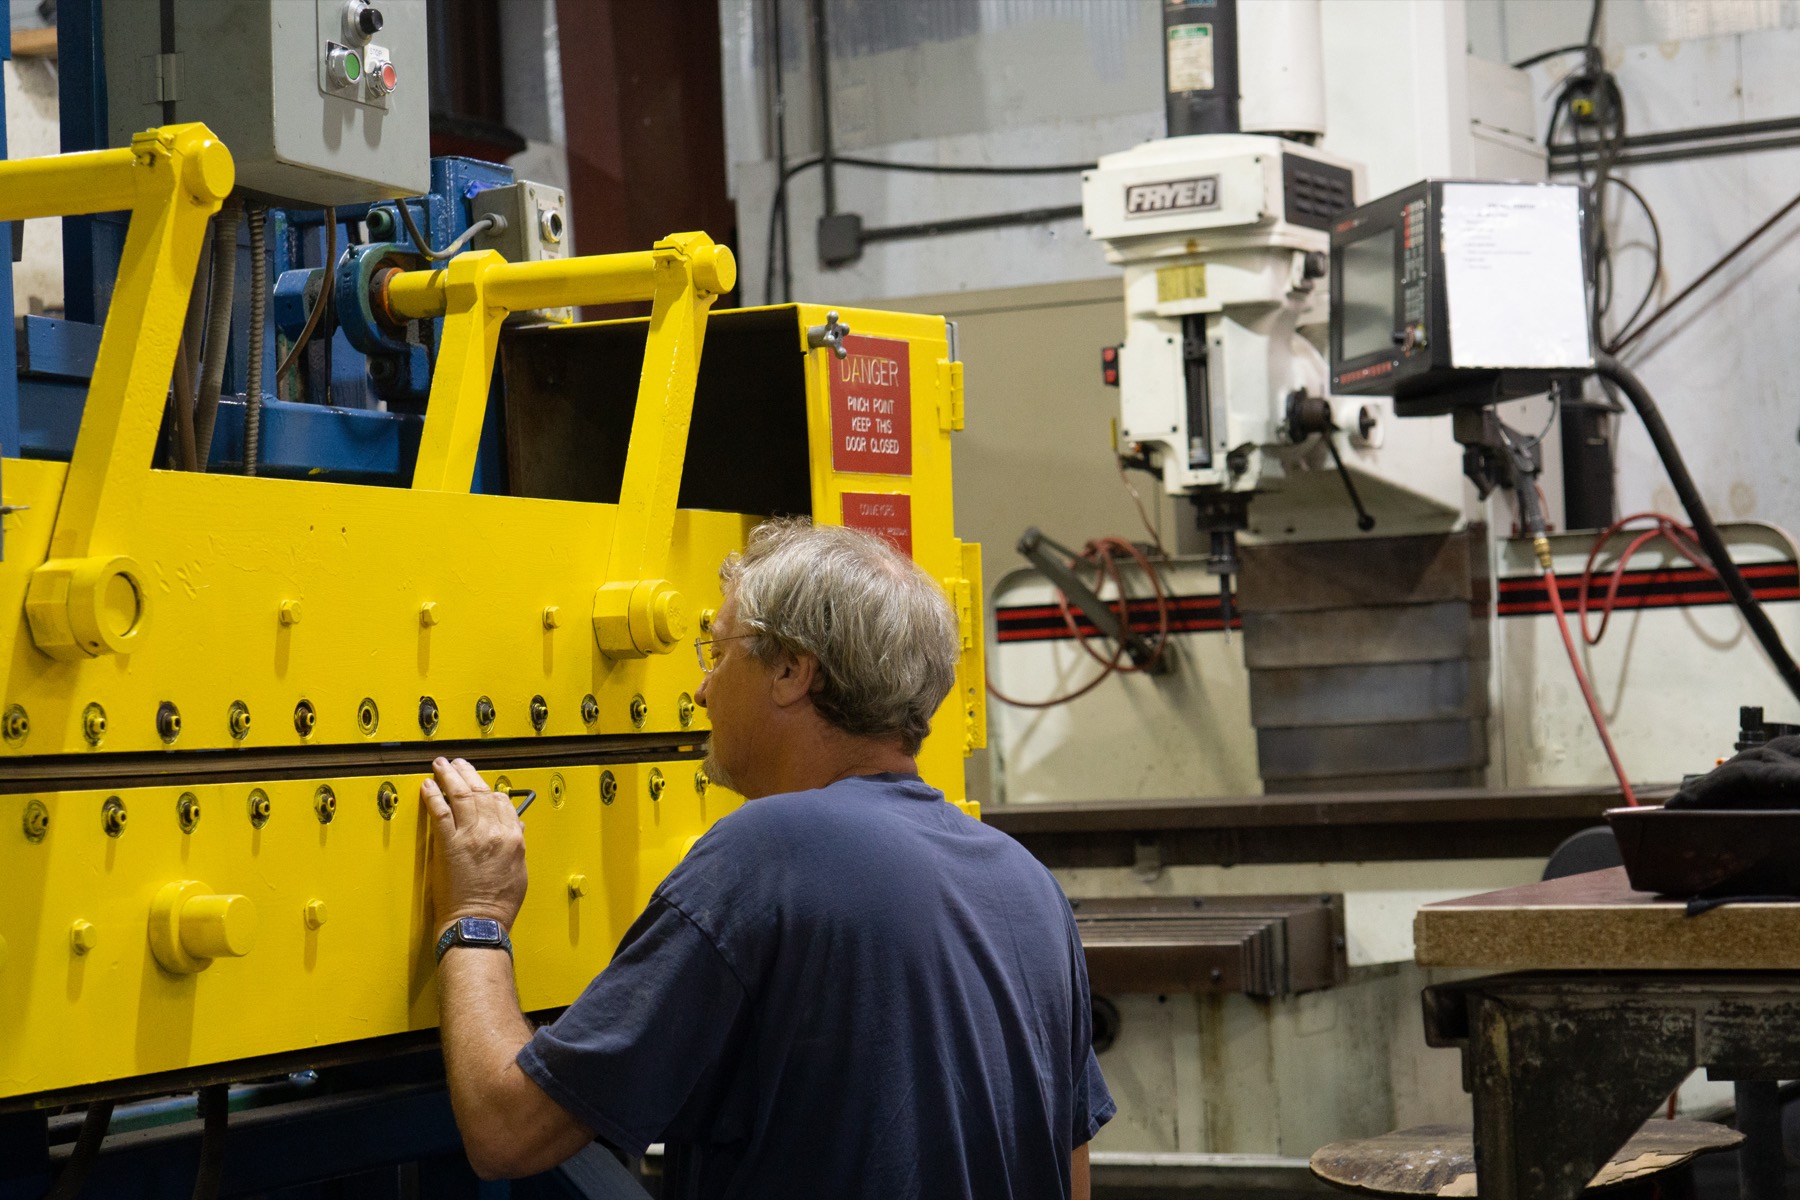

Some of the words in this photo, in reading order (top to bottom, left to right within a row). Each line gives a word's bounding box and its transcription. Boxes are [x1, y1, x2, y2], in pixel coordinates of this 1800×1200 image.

[1129, 180, 1214, 212] FRYER
[841, 357, 899, 387] DANGER
[847, 396, 870, 413] PINCH
[873, 398, 895, 415] POINT
[852, 417, 871, 432] KEEP
[876, 418, 892, 434] THIS
[846, 436, 866, 452] DOOR
[870, 438, 899, 454] CLOSED
